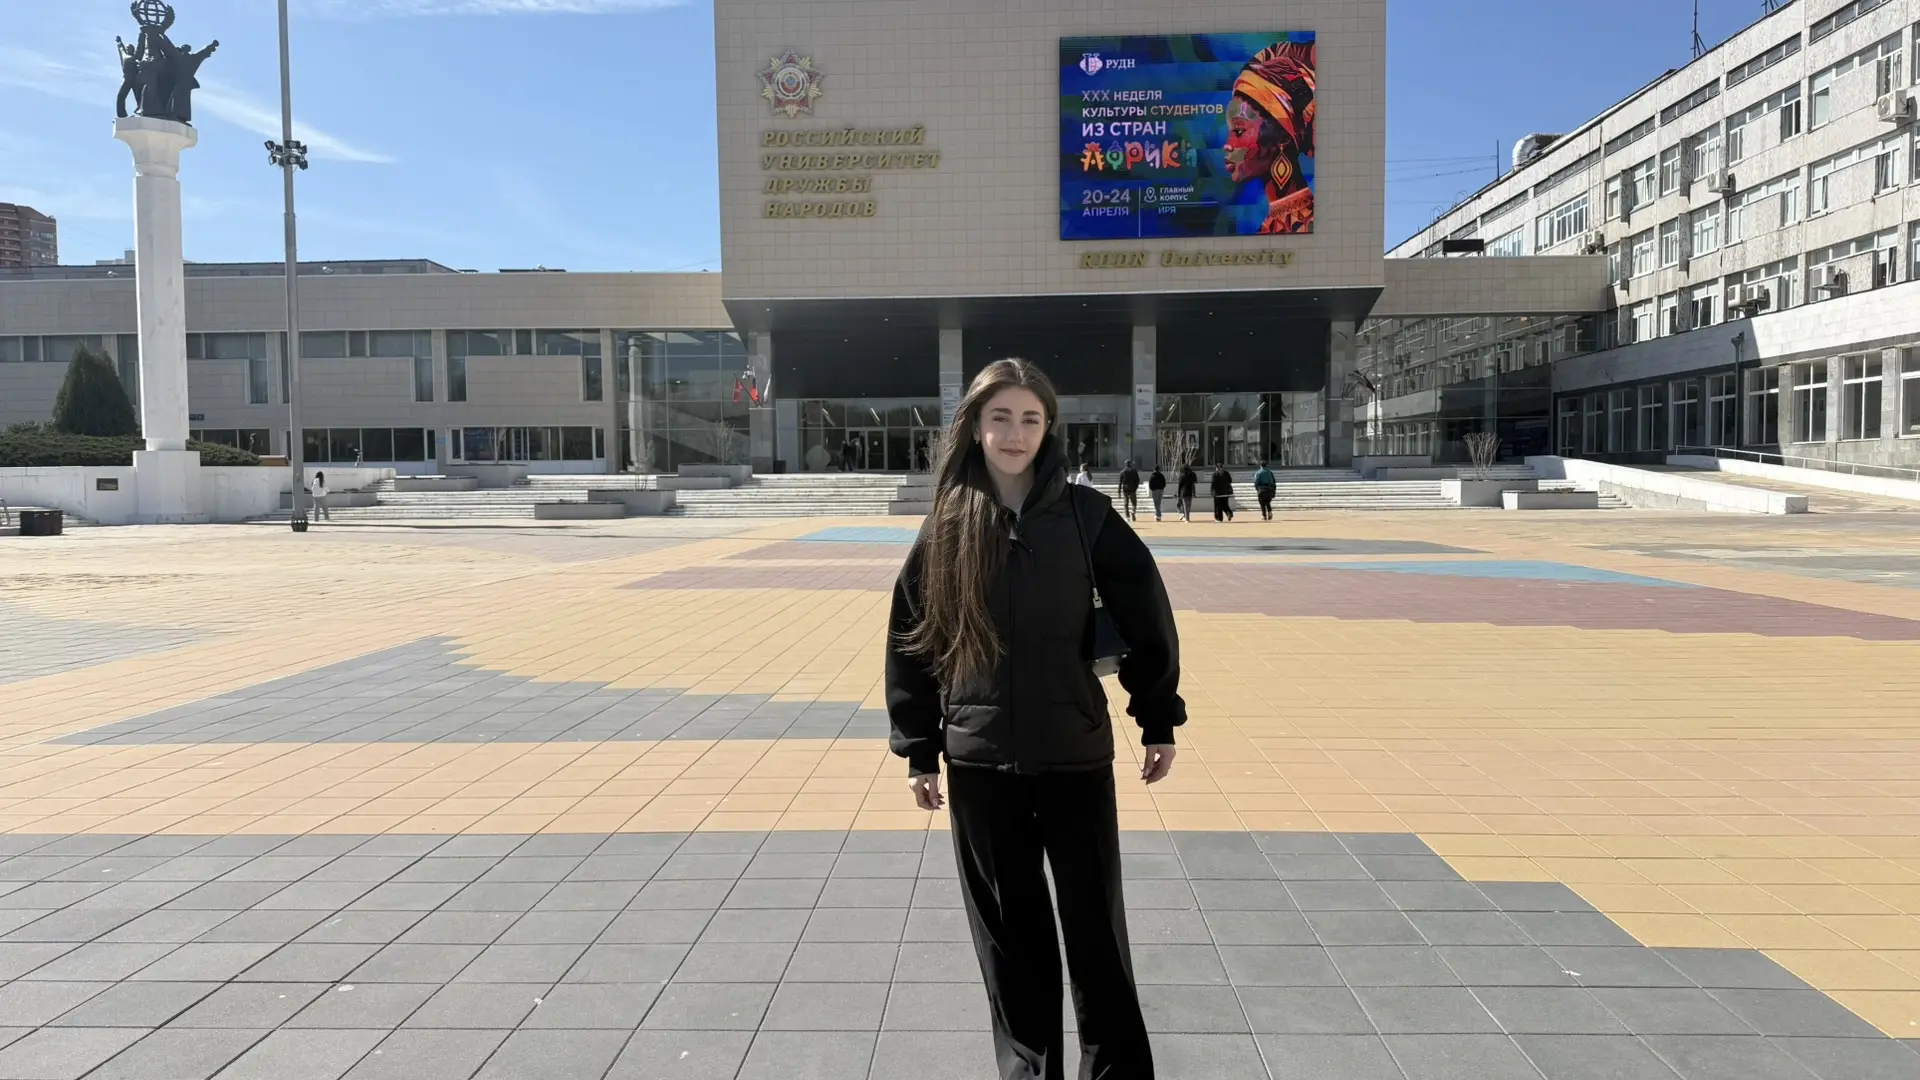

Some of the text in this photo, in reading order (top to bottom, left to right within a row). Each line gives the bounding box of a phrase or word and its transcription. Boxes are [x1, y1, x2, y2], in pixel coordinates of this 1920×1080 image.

[1106, 58, 1135, 70] РУДН
[1113, 90, 1162, 101] НЕДЕЛЯ
[1082, 104, 1224, 118] КУЛЬТУРЫ СТУДЕНТОВ
[761, 126, 925, 147] РОССИЙСКИЙ
[1082, 121, 1166, 137] ИЗ СТРАН
[761, 151, 941, 171] УНИВЕРСИТЕТ
[763, 176, 872, 195] ДРУЖБЫ
[1160, 185, 1194, 194] ГЛАВНЫЙ
[1082, 189, 1131, 204] 20-24
[763, 201, 877, 219] НАРОДОВ
[1082, 206, 1129, 217] АПРЕЛЯ
[1158, 206, 1176, 215] ИРЯ
[1080, 249, 1294, 269] RUDN University
